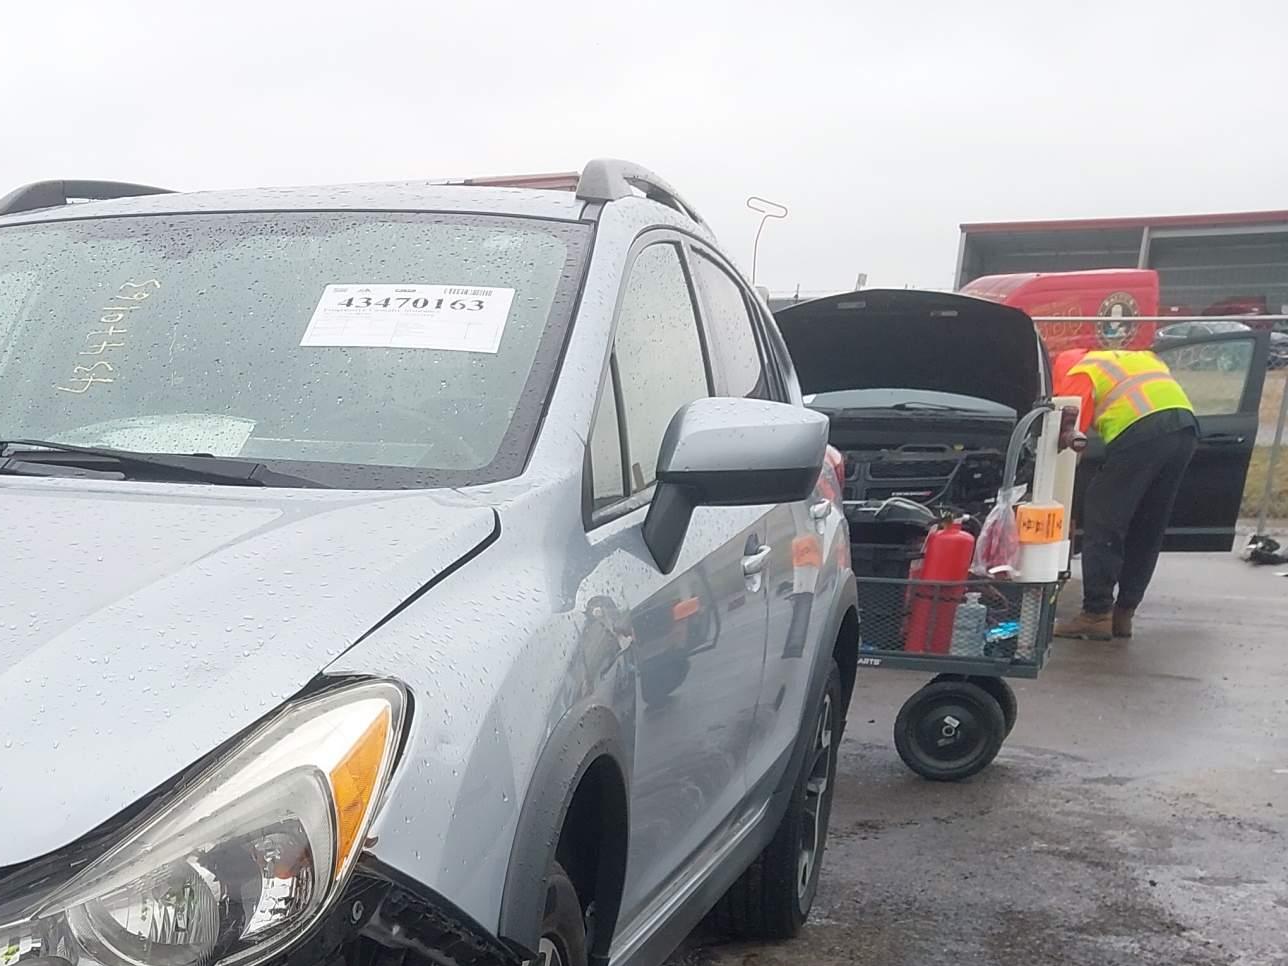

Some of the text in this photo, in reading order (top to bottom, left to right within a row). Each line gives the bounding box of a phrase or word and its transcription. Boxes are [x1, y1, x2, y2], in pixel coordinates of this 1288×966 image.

[337, 296, 485, 312] 43470163
[56, 278, 160, 393] 43470163
[856, 657, 881, 666] ARTS
